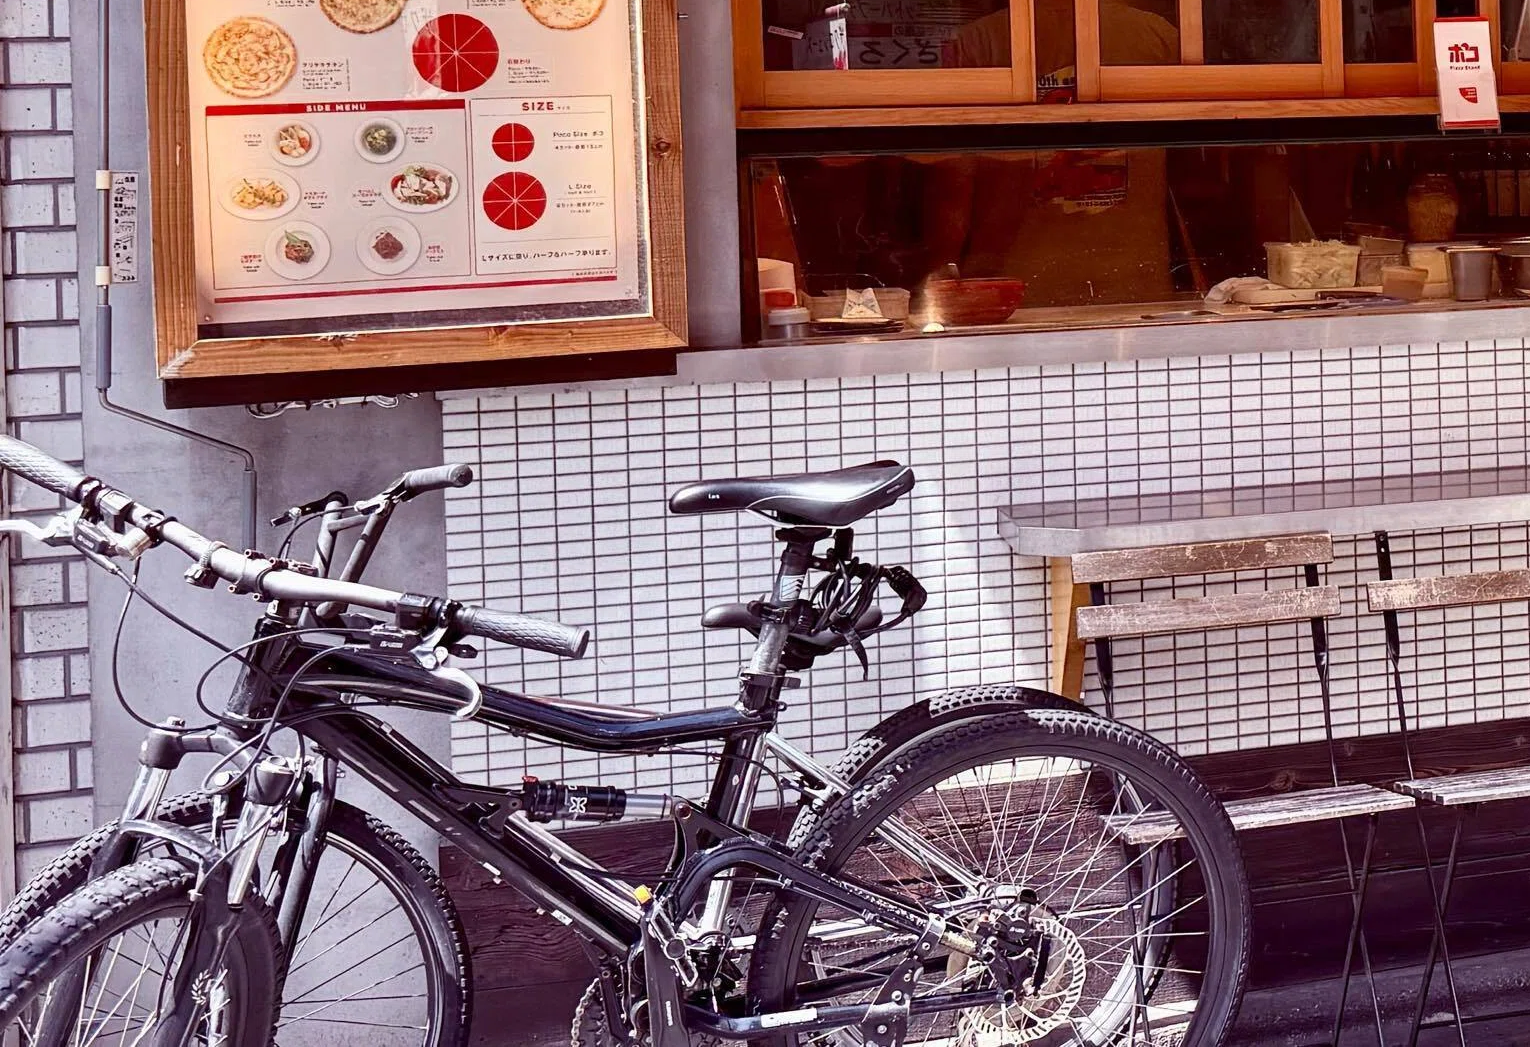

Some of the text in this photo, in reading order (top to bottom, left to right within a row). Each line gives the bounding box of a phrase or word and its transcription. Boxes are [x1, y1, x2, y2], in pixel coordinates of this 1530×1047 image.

[306, 103, 366, 112] SIDE MENU
[522, 101, 554, 111] SIZE
